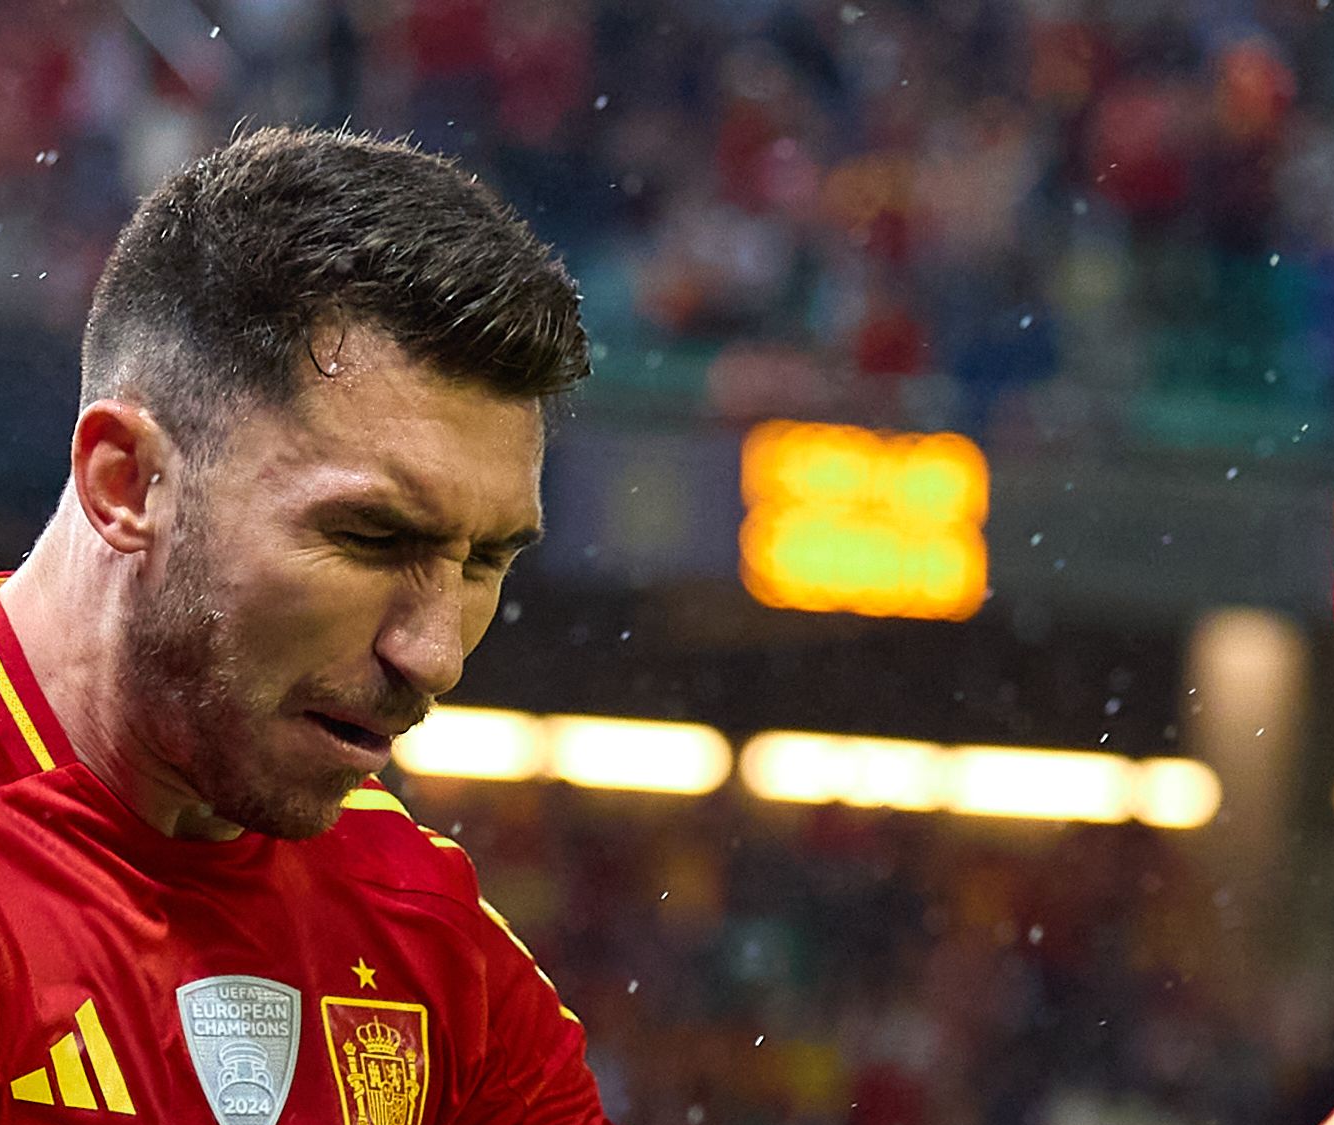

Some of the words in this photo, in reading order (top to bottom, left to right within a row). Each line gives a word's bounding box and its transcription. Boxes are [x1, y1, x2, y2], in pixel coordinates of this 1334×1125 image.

[218, 986, 259, 1000] UEFA
[192, 1002, 288, 1020] EUROPEAN
[193, 1020, 290, 1037] CHAMPIONS
[223, 1098, 272, 1115] 2024
